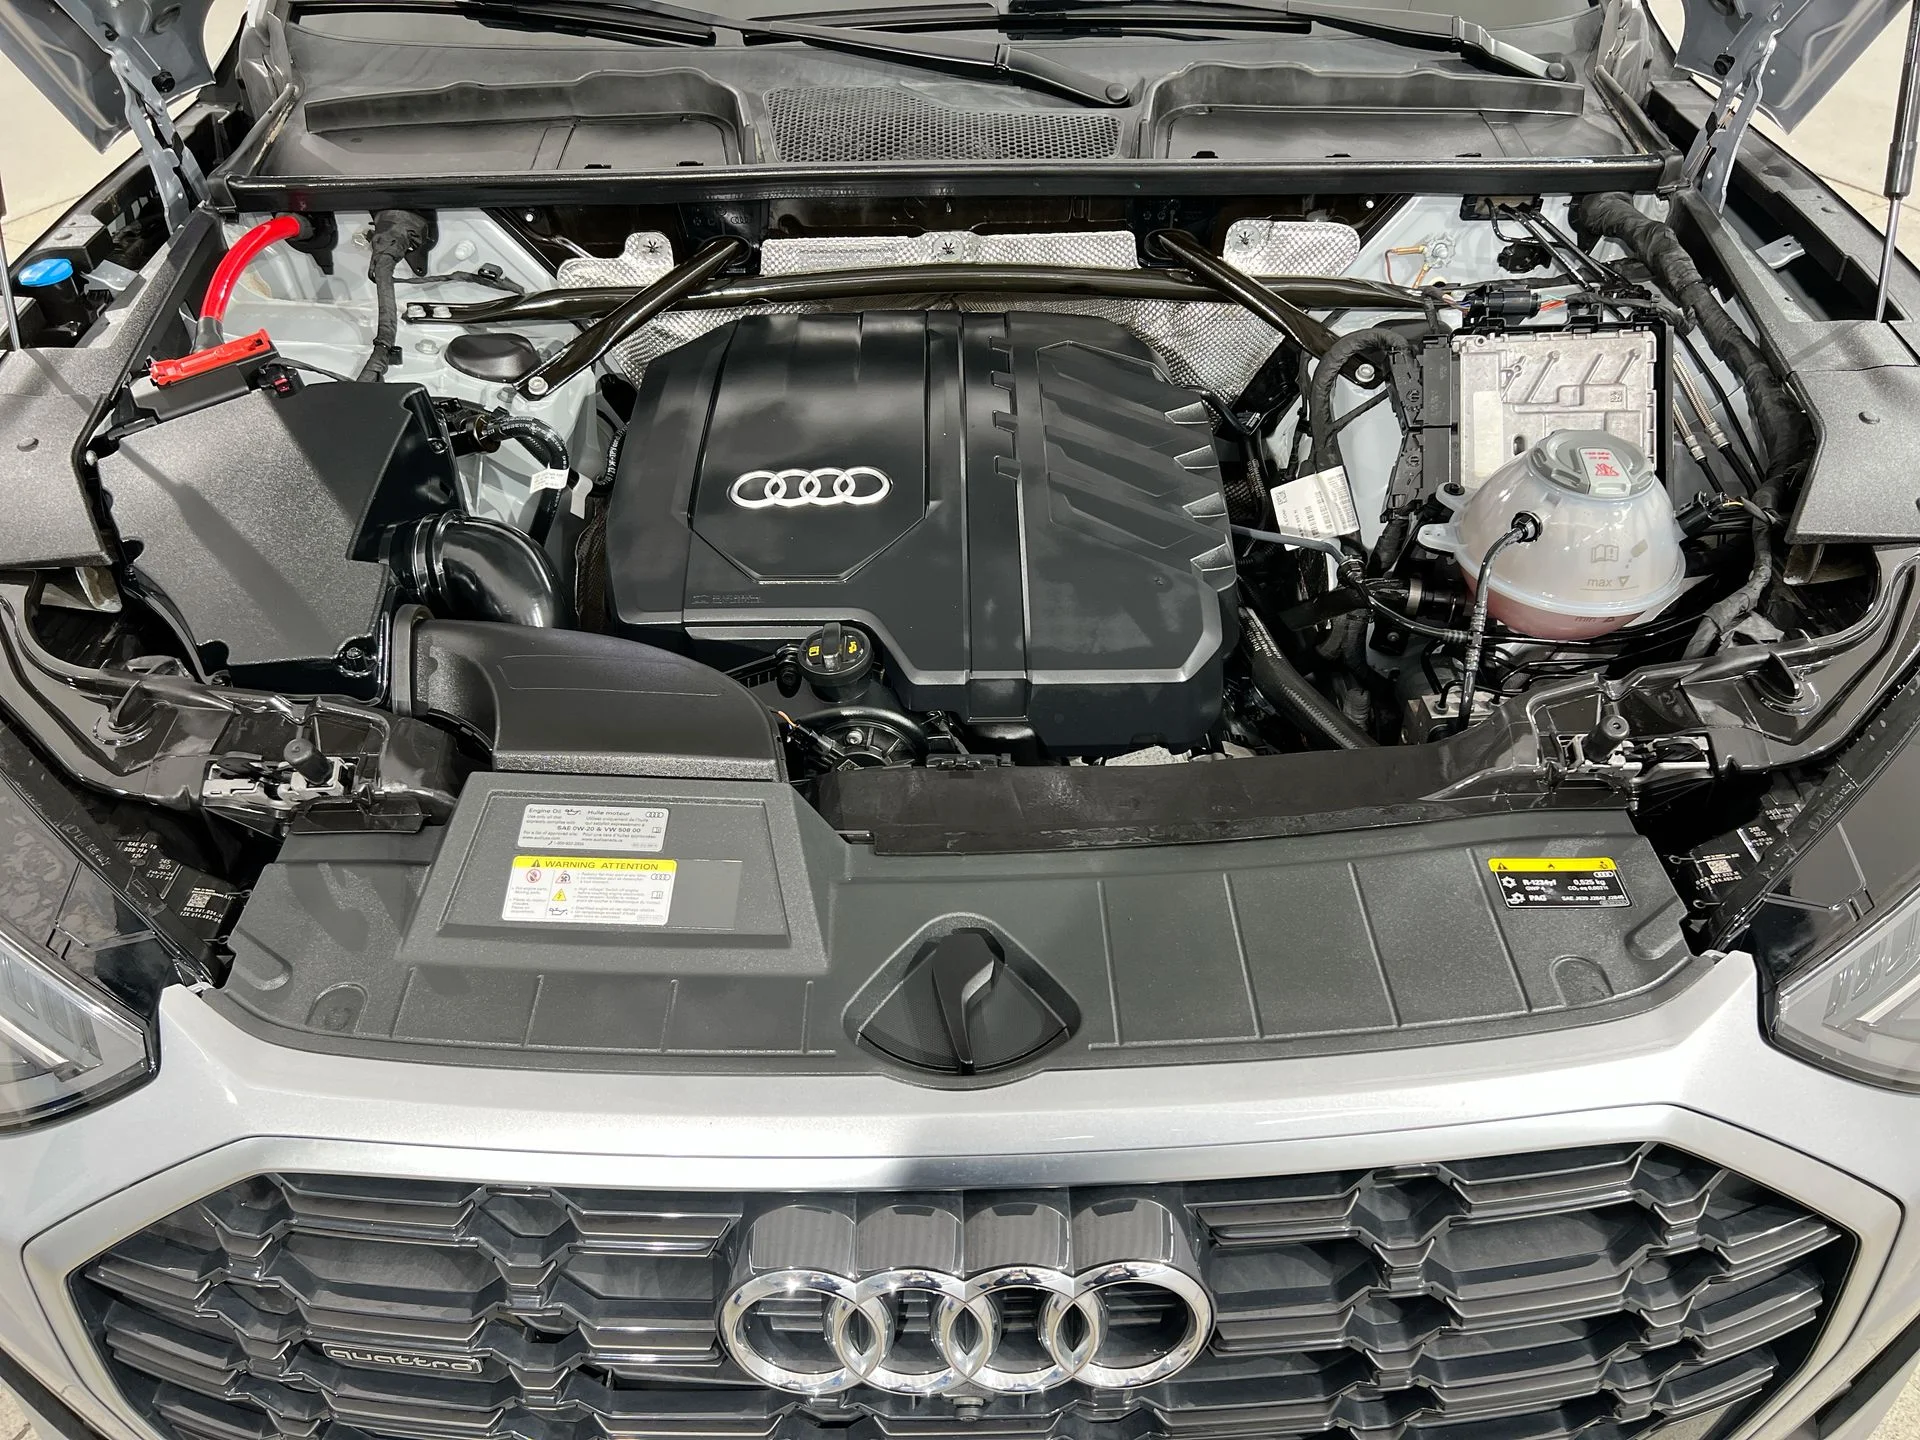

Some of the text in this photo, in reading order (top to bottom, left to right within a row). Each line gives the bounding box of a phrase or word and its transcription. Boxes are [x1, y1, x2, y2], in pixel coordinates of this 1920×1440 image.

[1587, 578, 1613, 588] max
[545, 860, 659, 871] WARNING ATTENTION
[1595, 878, 1607, 886] kg
[1528, 894, 1548, 902] PAG
[329, 1348, 473, 1371] quattro
